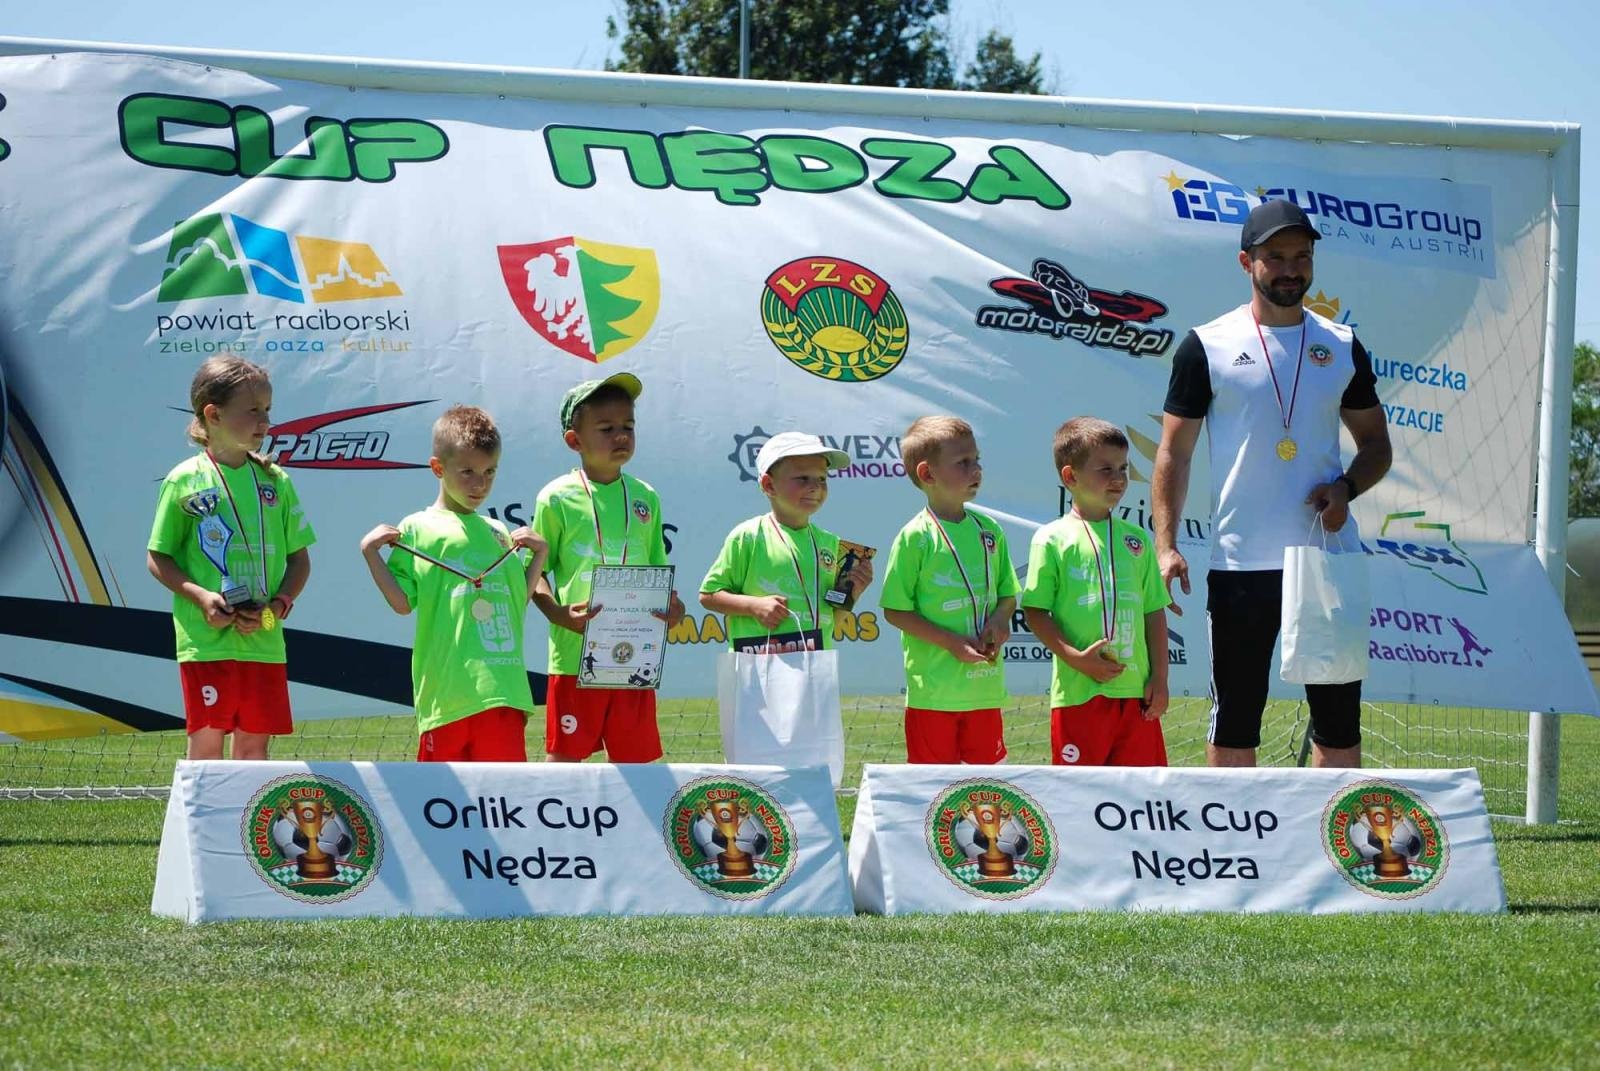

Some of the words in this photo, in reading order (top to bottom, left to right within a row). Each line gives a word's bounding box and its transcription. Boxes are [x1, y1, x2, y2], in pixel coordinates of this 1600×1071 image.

[117, 92, 449, 183] CUP
[543, 123, 1072, 210] NĘDZA
[1172, 178, 1248, 224] EG
[1360, 228, 1376, 246] W
[1391, 236, 1485, 262] AUSTRII
[776, 263, 876, 297] LZS
[157, 309, 256, 336] powiat
[276, 309, 410, 331] raciborski
[159, 337, 247, 353] zielona
[266, 340, 324, 353] oaza
[202, 685, 218, 706] 9
[561, 714, 578, 735] 9
[706, 789, 739, 800] CUP
[255, 805, 275, 858] ORLIK
[289, 787, 325, 800] CUP
[423, 796, 527, 829] Orlik
[537, 798, 618, 837] Cup
[938, 808, 956, 857] ORLIK
[968, 791, 1002, 802] CUP
[1094, 800, 1192, 831] Orlik
[1201, 803, 1278, 839] Cup
[1334, 810, 1351, 858] ORLIK
[1361, 793, 1393, 804] CUP
[462, 847, 597, 886] Nędza
[1132, 849, 1259, 886] Nędza
